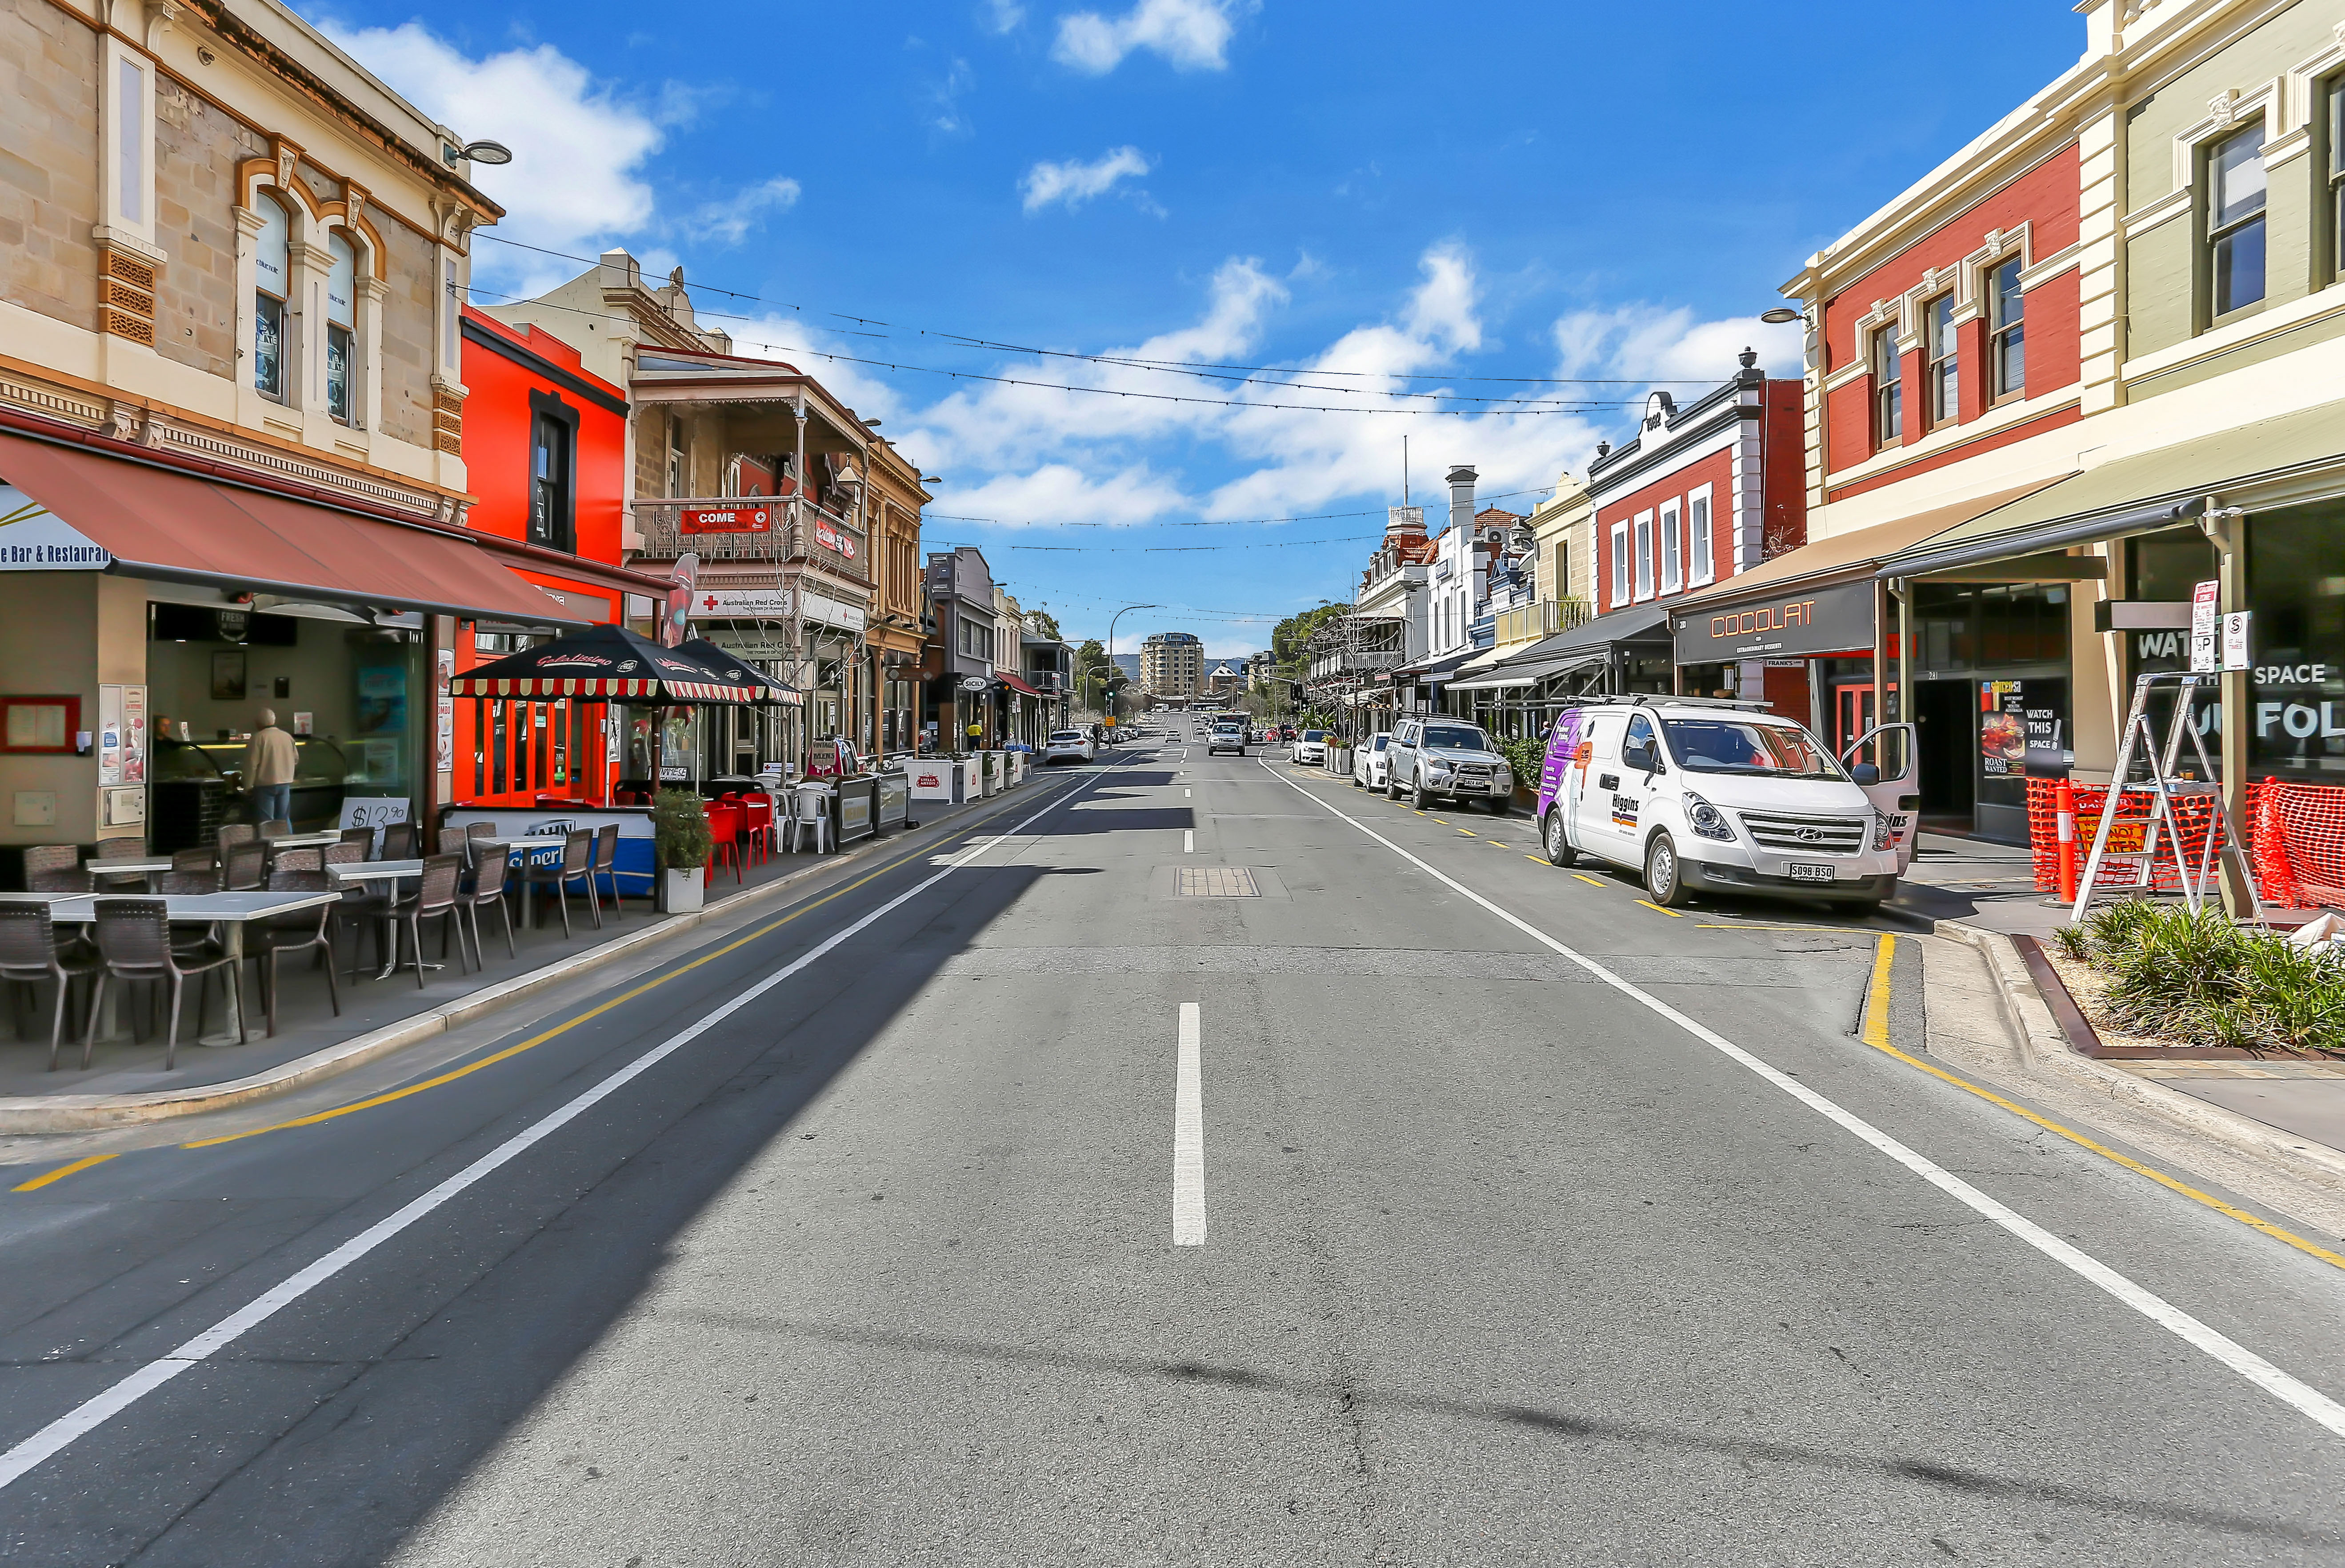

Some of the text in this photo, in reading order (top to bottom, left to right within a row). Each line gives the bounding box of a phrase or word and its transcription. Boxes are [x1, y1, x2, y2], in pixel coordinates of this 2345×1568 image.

[1646, 412, 1661, 432] 1982
[699, 513, 735, 523] COME
[12, 545, 32, 562] Bar
[36, 545, 44, 562] &
[48, 545, 113, 562] Restauran
[1711, 600, 1815, 638] COCOLAT
[2139, 632, 2191, 659] WAT
[1929, 672, 1938, 680] 281
[2254, 664, 2325, 684] SPACE
[437, 706, 450, 714] OMBO
[2026, 710, 2053, 718] WATCH
[2028, 722, 2051, 733] THIS
[2029, 740, 2050, 748] SPACE
[1985, 758, 2007, 766] ROAST
[659, 768, 687, 776] NAMESE
[1613, 793, 1639, 812] Higgins
